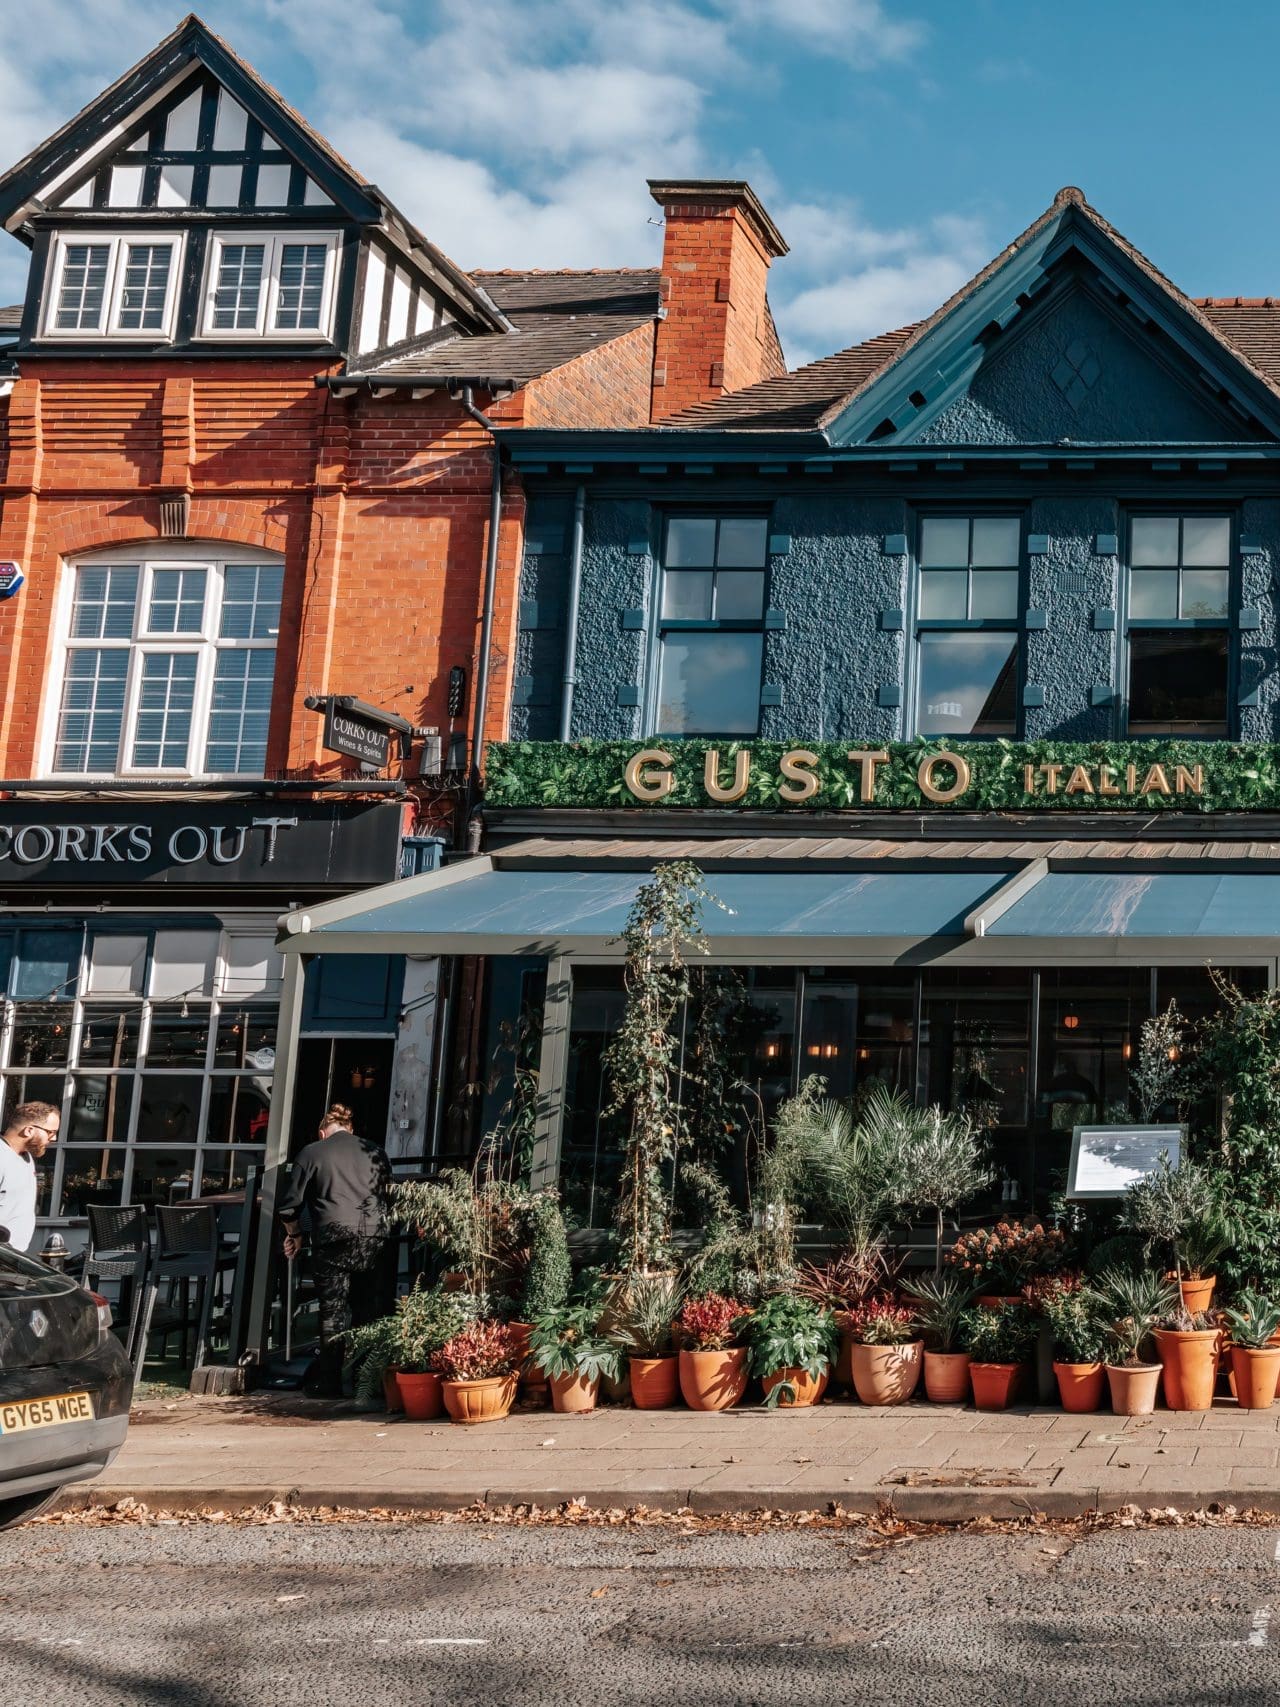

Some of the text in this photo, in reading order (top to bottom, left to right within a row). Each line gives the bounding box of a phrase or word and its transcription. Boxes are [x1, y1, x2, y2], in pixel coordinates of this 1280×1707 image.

[334, 716, 388, 748] CORKS OUT
[339, 736, 381, 759] Wines & Spirits
[625, 749, 1203, 802] GUSTO ITALIAN
[168, 817, 298, 864] OUT
[3, 1396, 89, 1429] GY65 WGE
